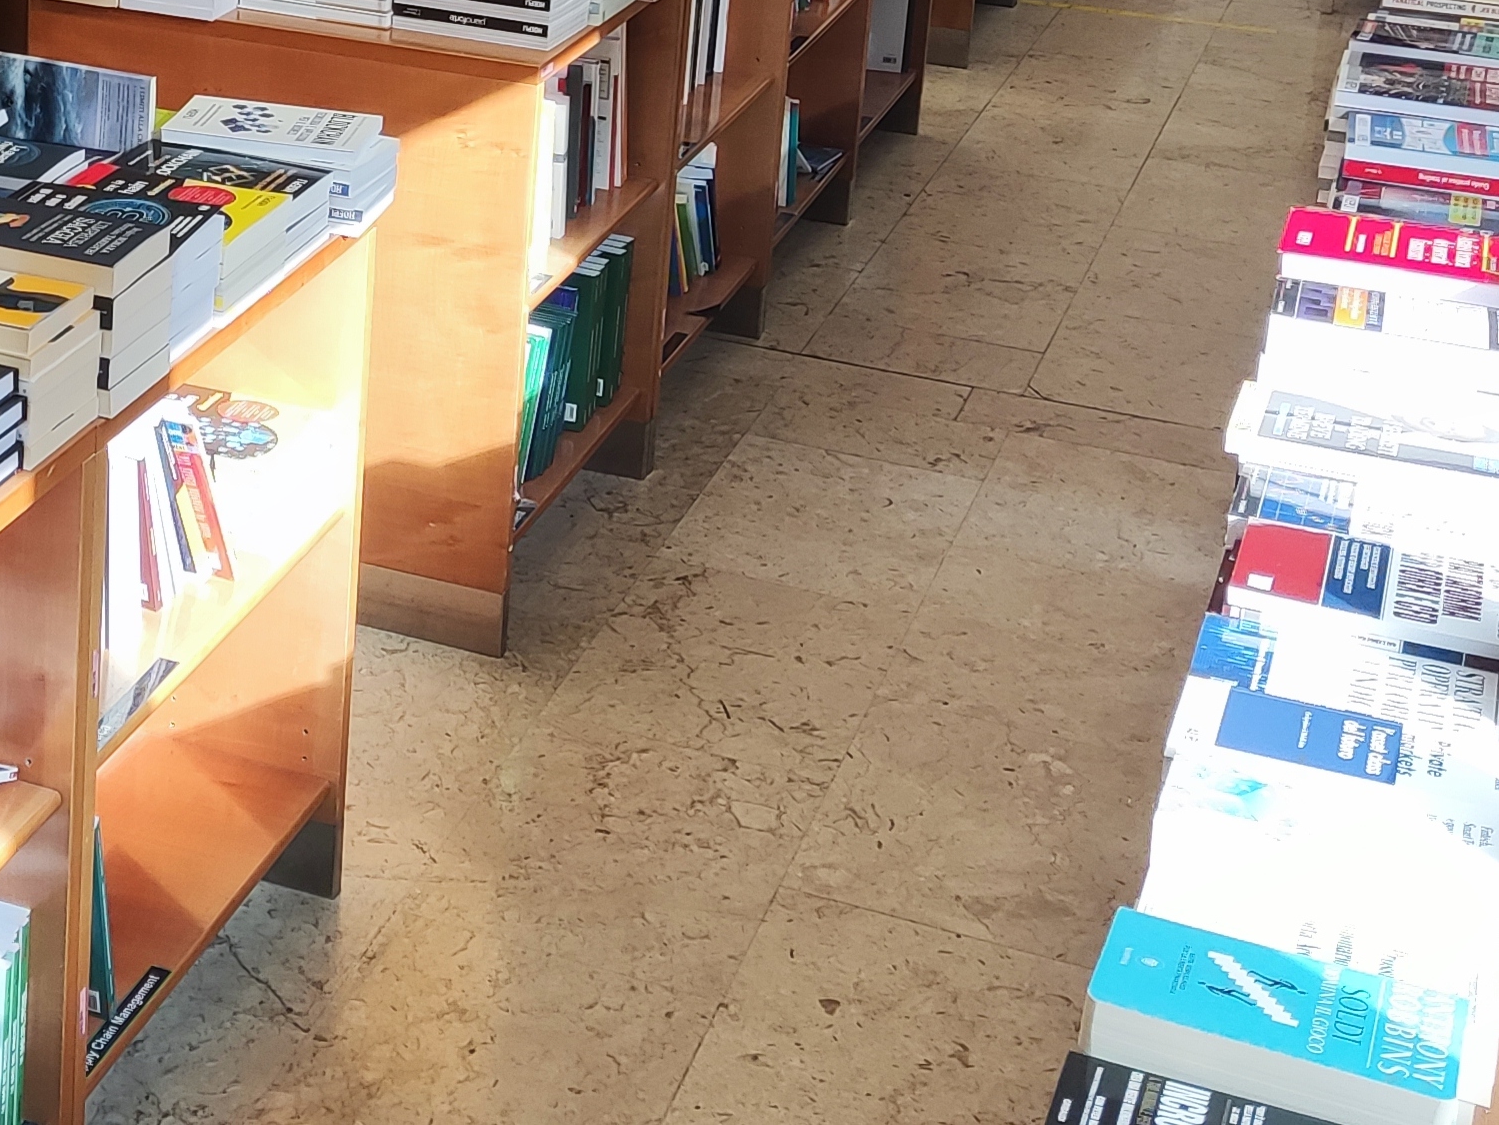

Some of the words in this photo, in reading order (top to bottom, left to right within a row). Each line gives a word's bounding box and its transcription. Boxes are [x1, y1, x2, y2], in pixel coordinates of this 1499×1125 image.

[1426, 0, 1466, 11] PROSPECTING
[91, 1026, 119, 1050] Chain
[110, 975, 161, 1026] Management
[1305, 1017, 1327, 1055] GIOCO
[1332, 984, 1372, 1047] SOLDI
